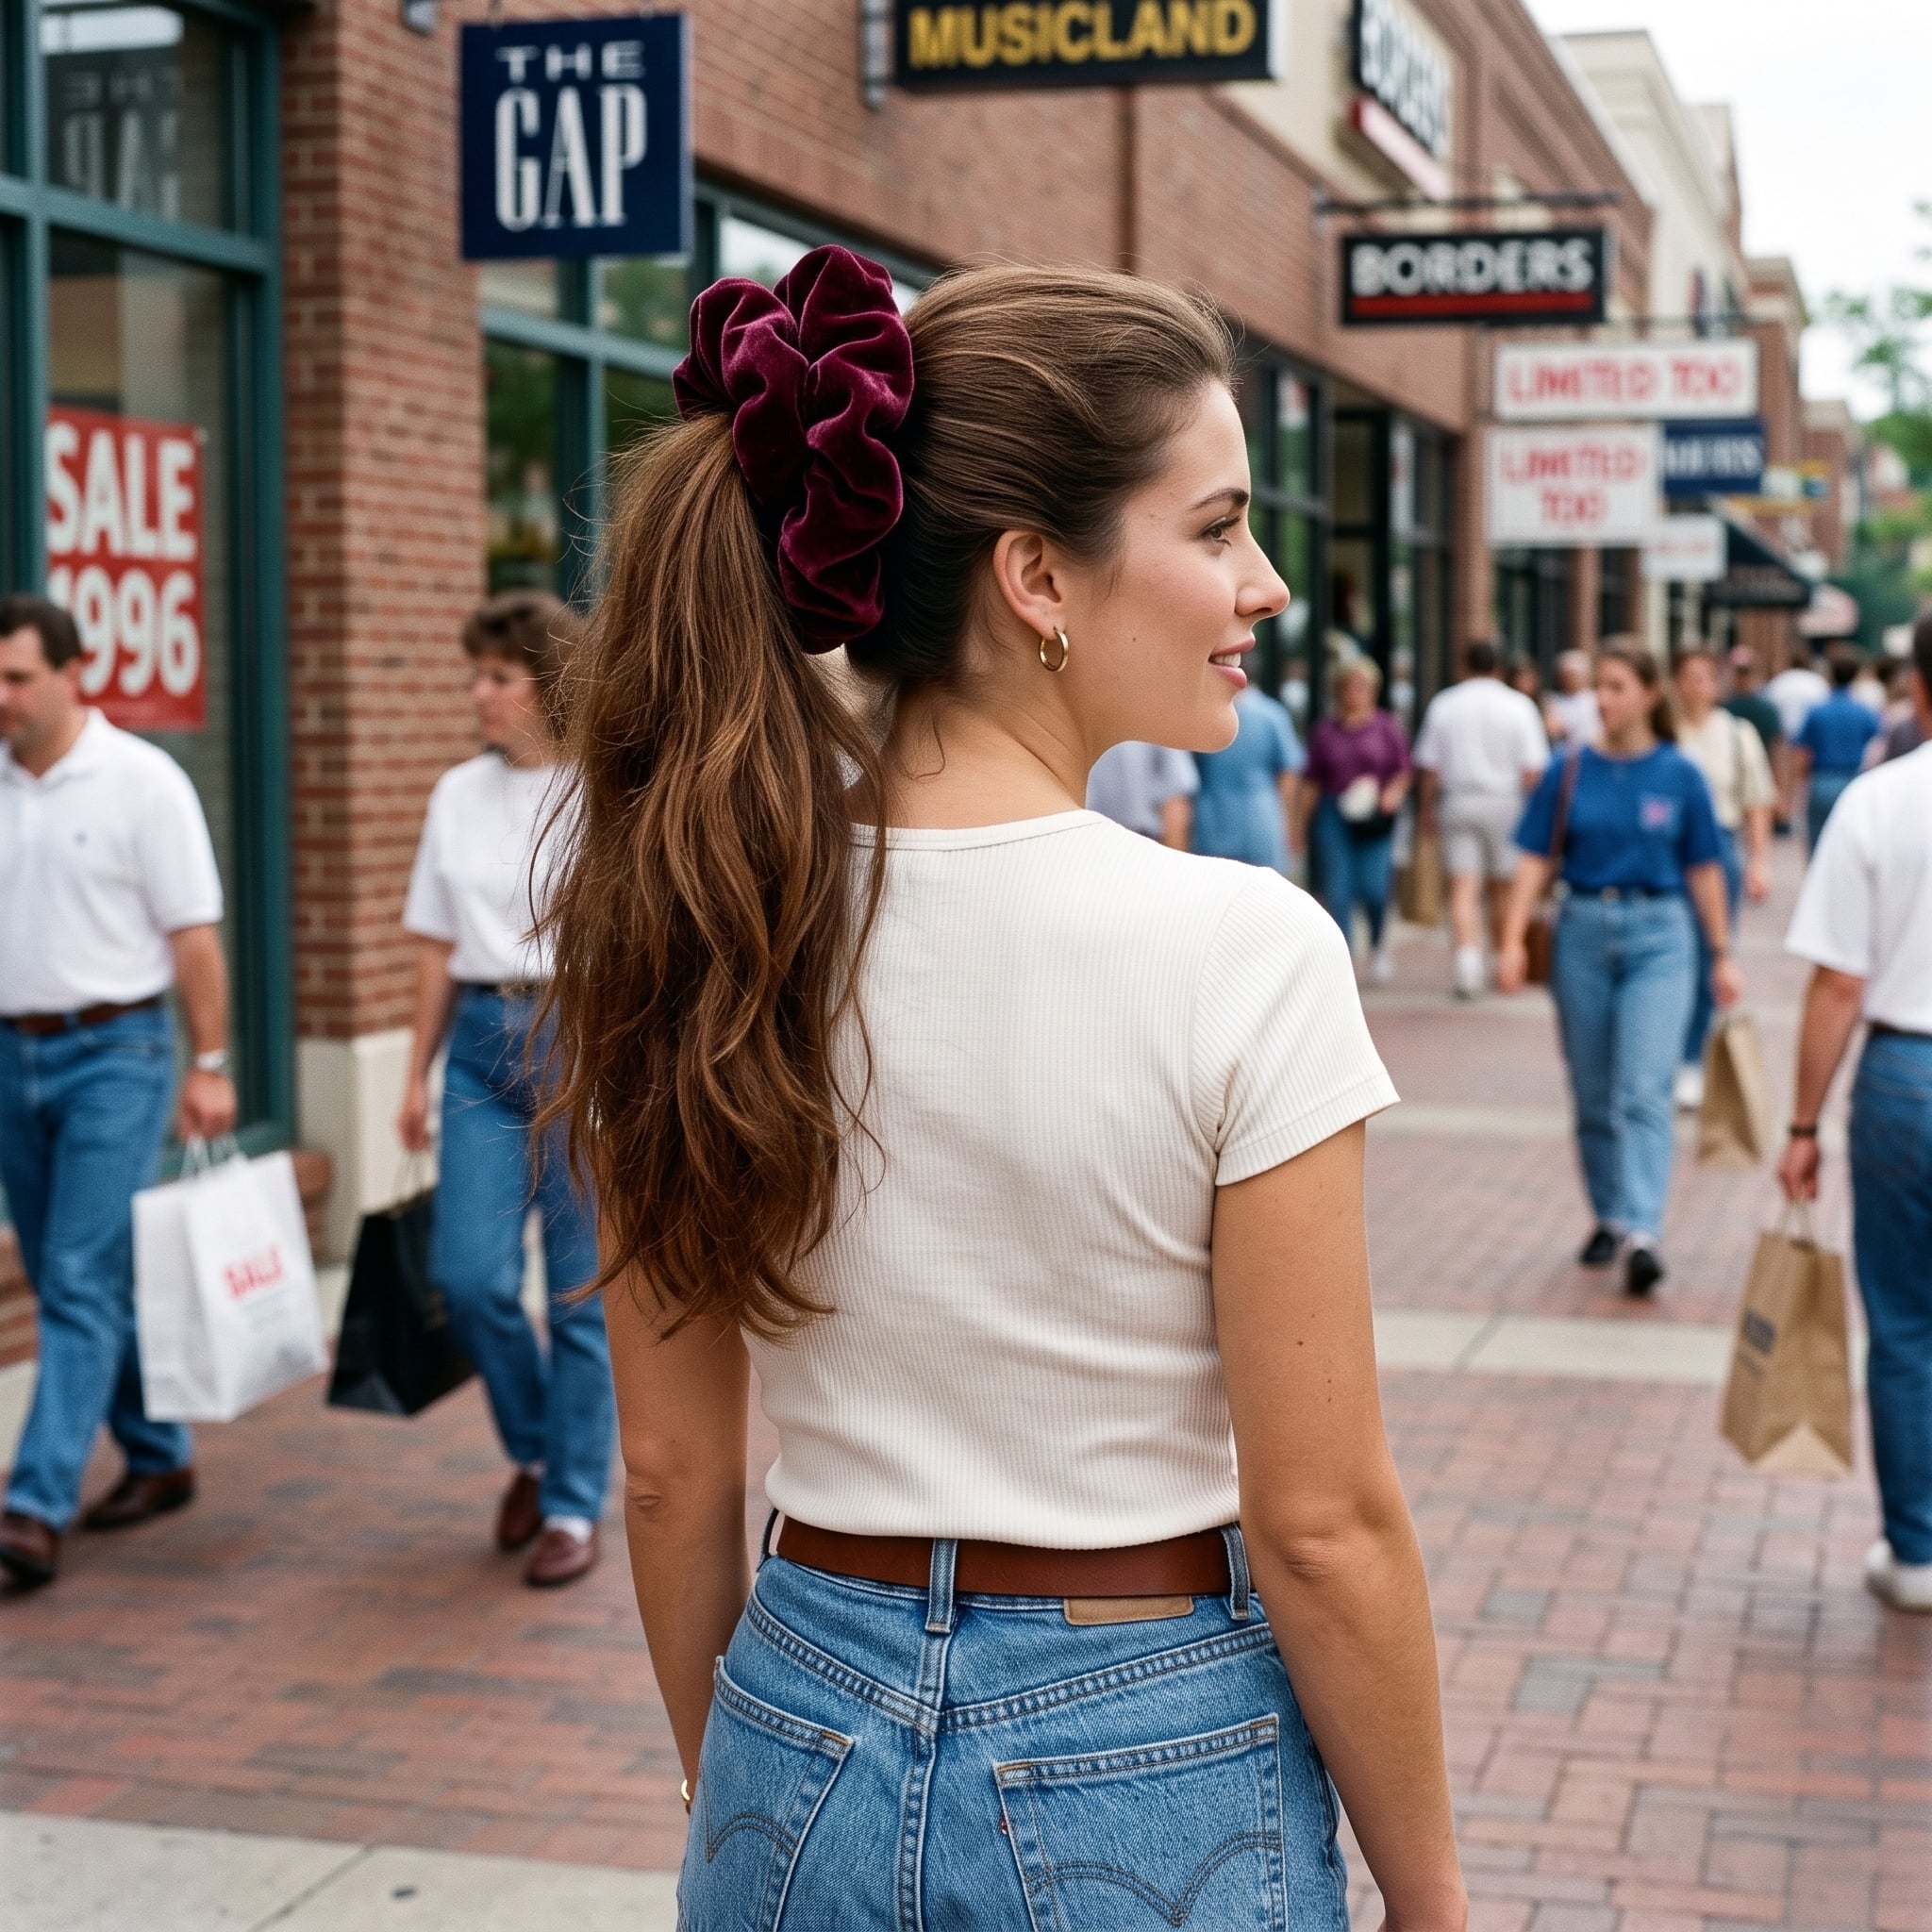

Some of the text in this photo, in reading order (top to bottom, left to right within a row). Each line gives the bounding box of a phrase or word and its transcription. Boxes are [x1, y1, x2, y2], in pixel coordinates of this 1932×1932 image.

[495, 41, 645, 84] THE
[909, 0, 1257, 69] MUSICLAND
[495, 82, 648, 232] GAP
[1351, 238, 1594, 297] BORDERS
[45, 423, 197, 561] SALE
[47, 565, 201, 696] 996
